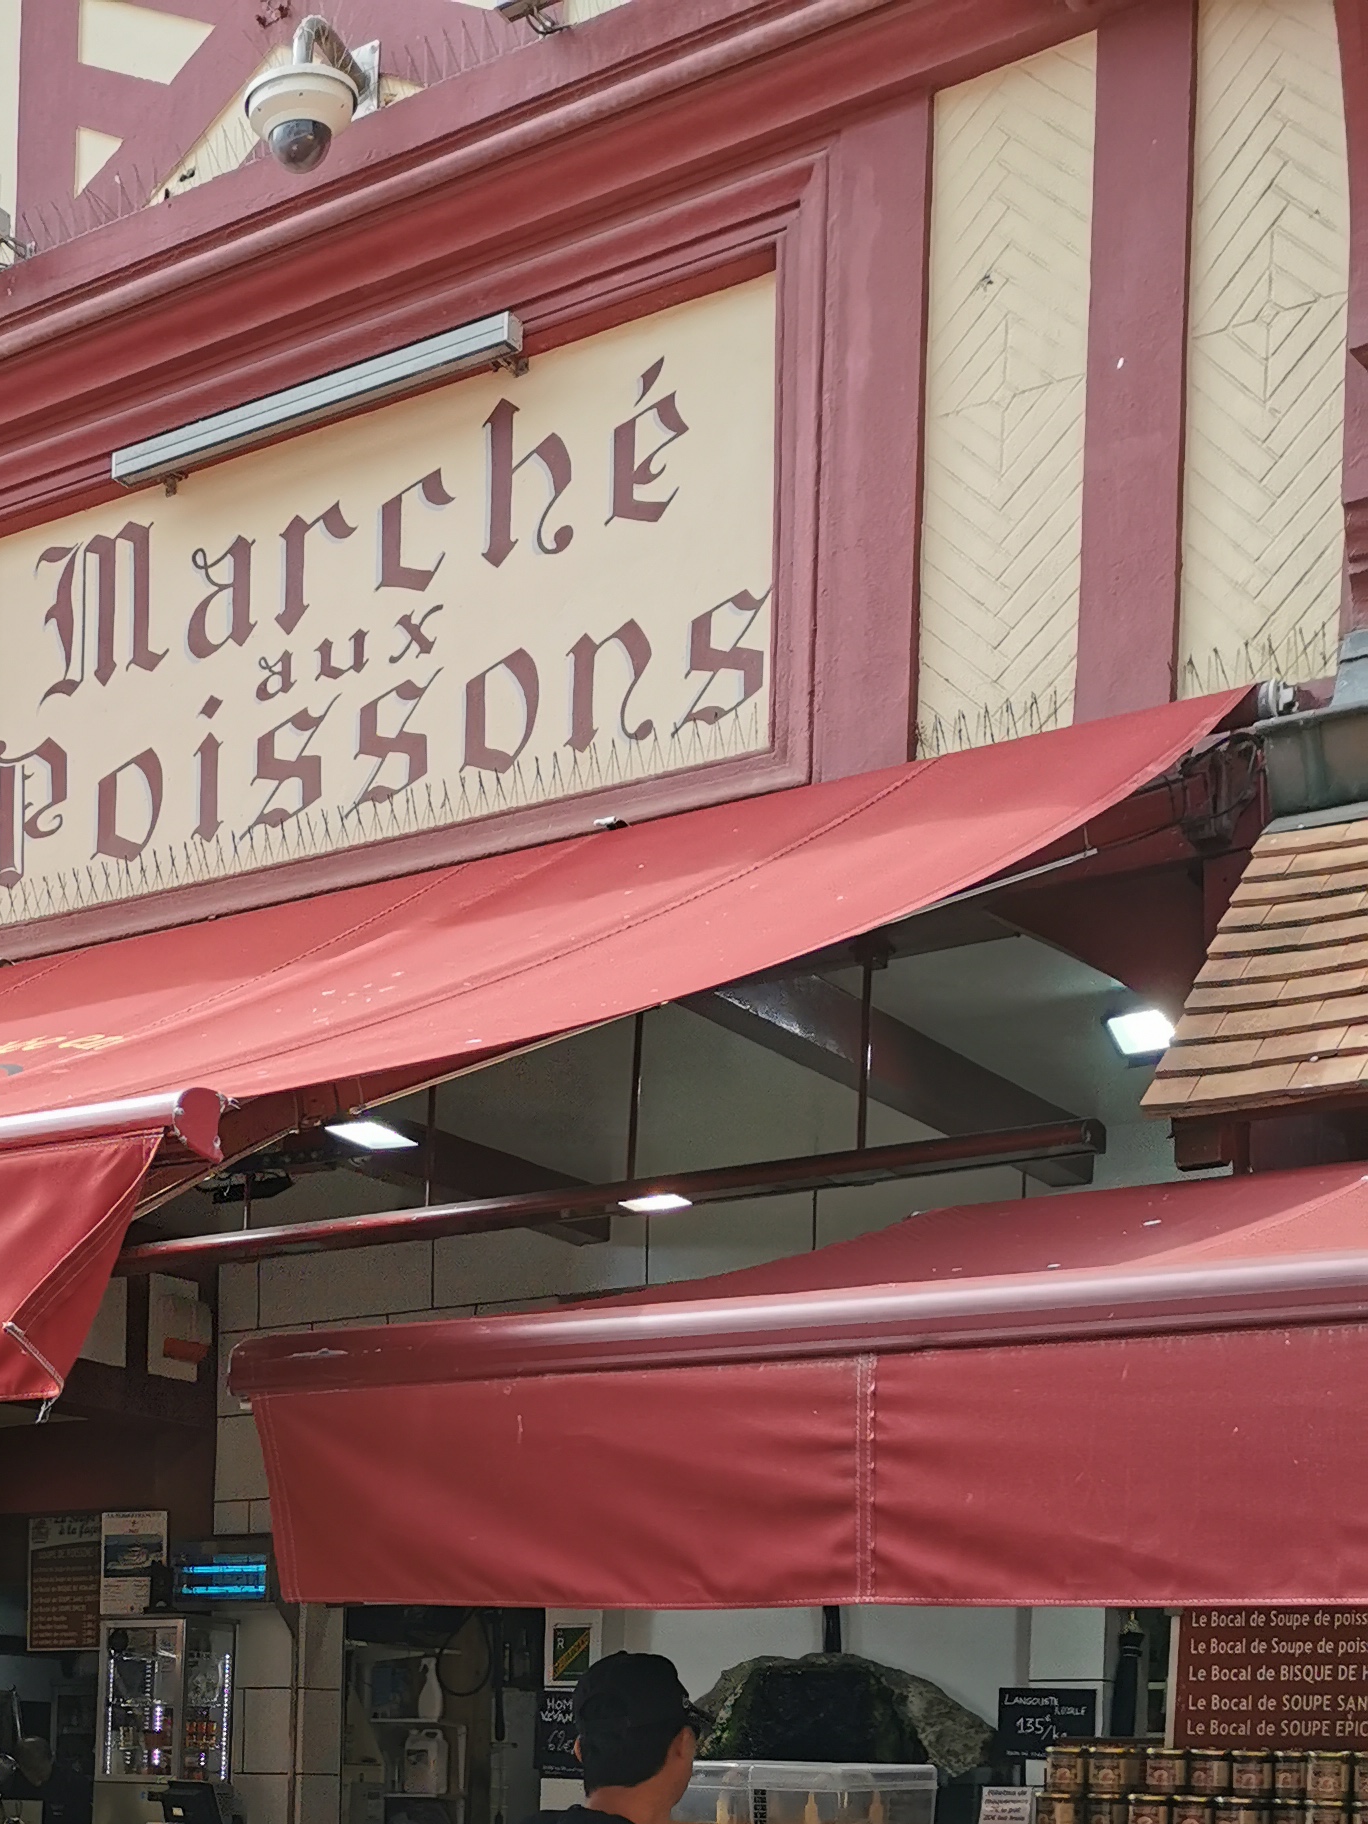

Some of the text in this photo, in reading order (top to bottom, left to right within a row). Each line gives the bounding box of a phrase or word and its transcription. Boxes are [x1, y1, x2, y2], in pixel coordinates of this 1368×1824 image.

[35, 356, 690, 712] Marché
[255, 603, 444, 703] aux
[1191, 1611, 1208, 1628] Le
[1210, 1610, 1245, 1627] Bocal
[1249, 1610, 1266, 1627] de
[1269, 1610, 1310, 1630] Soupe
[1314, 1609, 1331, 1626] de
[1190, 1638, 1206, 1654] Le
[1210, 1637, 1246, 1654] Bocal
[1250, 1638, 1268, 1654] de
[1271, 1637, 1313, 1657] Soupe
[1316, 1637, 1334, 1653] de
[1188, 1665, 1207, 1681] Le
[1211, 1665, 1252, 1681] Bocal
[1256, 1665, 1275, 1681] de
[1280, 1664, 1333, 1684] BISQUE
[1338, 1664, 1357, 1681] DE
[546, 1697, 574, 1711] HOM
[1188, 1694, 1207, 1711] Le
[1211, 1694, 1252, 1711] Bocal
[1257, 1694, 1277, 1711] de
[1282, 1694, 1332, 1711] SOUPE
[1186, 1719, 1205, 1736] Le
[1209, 1719, 1251, 1736] Bocal
[1256, 1719, 1275, 1736] de
[1280, 1719, 1331, 1737] SOUPE
